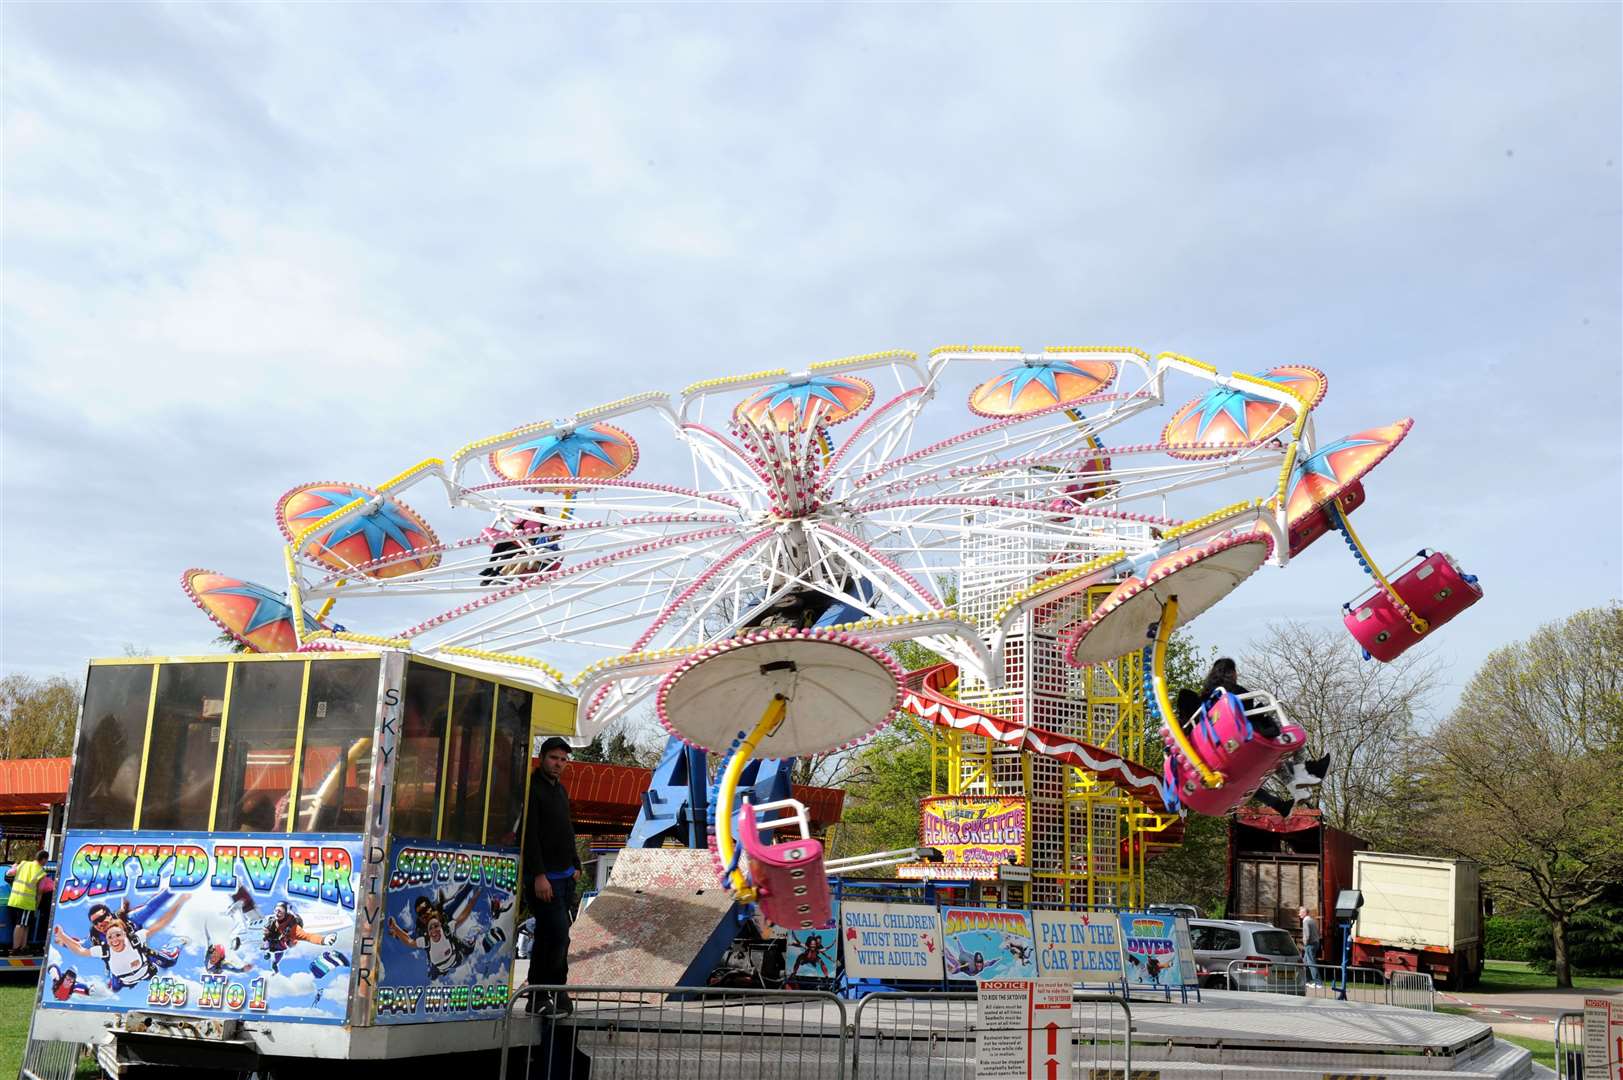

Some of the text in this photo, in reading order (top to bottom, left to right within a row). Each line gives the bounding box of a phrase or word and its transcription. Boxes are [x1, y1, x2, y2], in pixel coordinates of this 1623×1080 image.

[60, 844, 354, 909] SKYDIVER
[390, 848, 517, 895] SKYDIVER
[846, 912, 935, 929] SMALL CHILDREN
[945, 910, 1031, 940] SKYDIVER
[1132, 919, 1164, 937] SKY
[862, 932, 919, 948] MUST RIDE
[1041, 923, 1114, 945] PAY IN THE
[1127, 938, 1174, 954] DIVER
[857, 950, 927, 967] WITH ADULTS
[1042, 950, 1121, 971] CAR PLEASE
[377, 987, 423, 1014] PAY
[472, 985, 510, 1009] CAR
